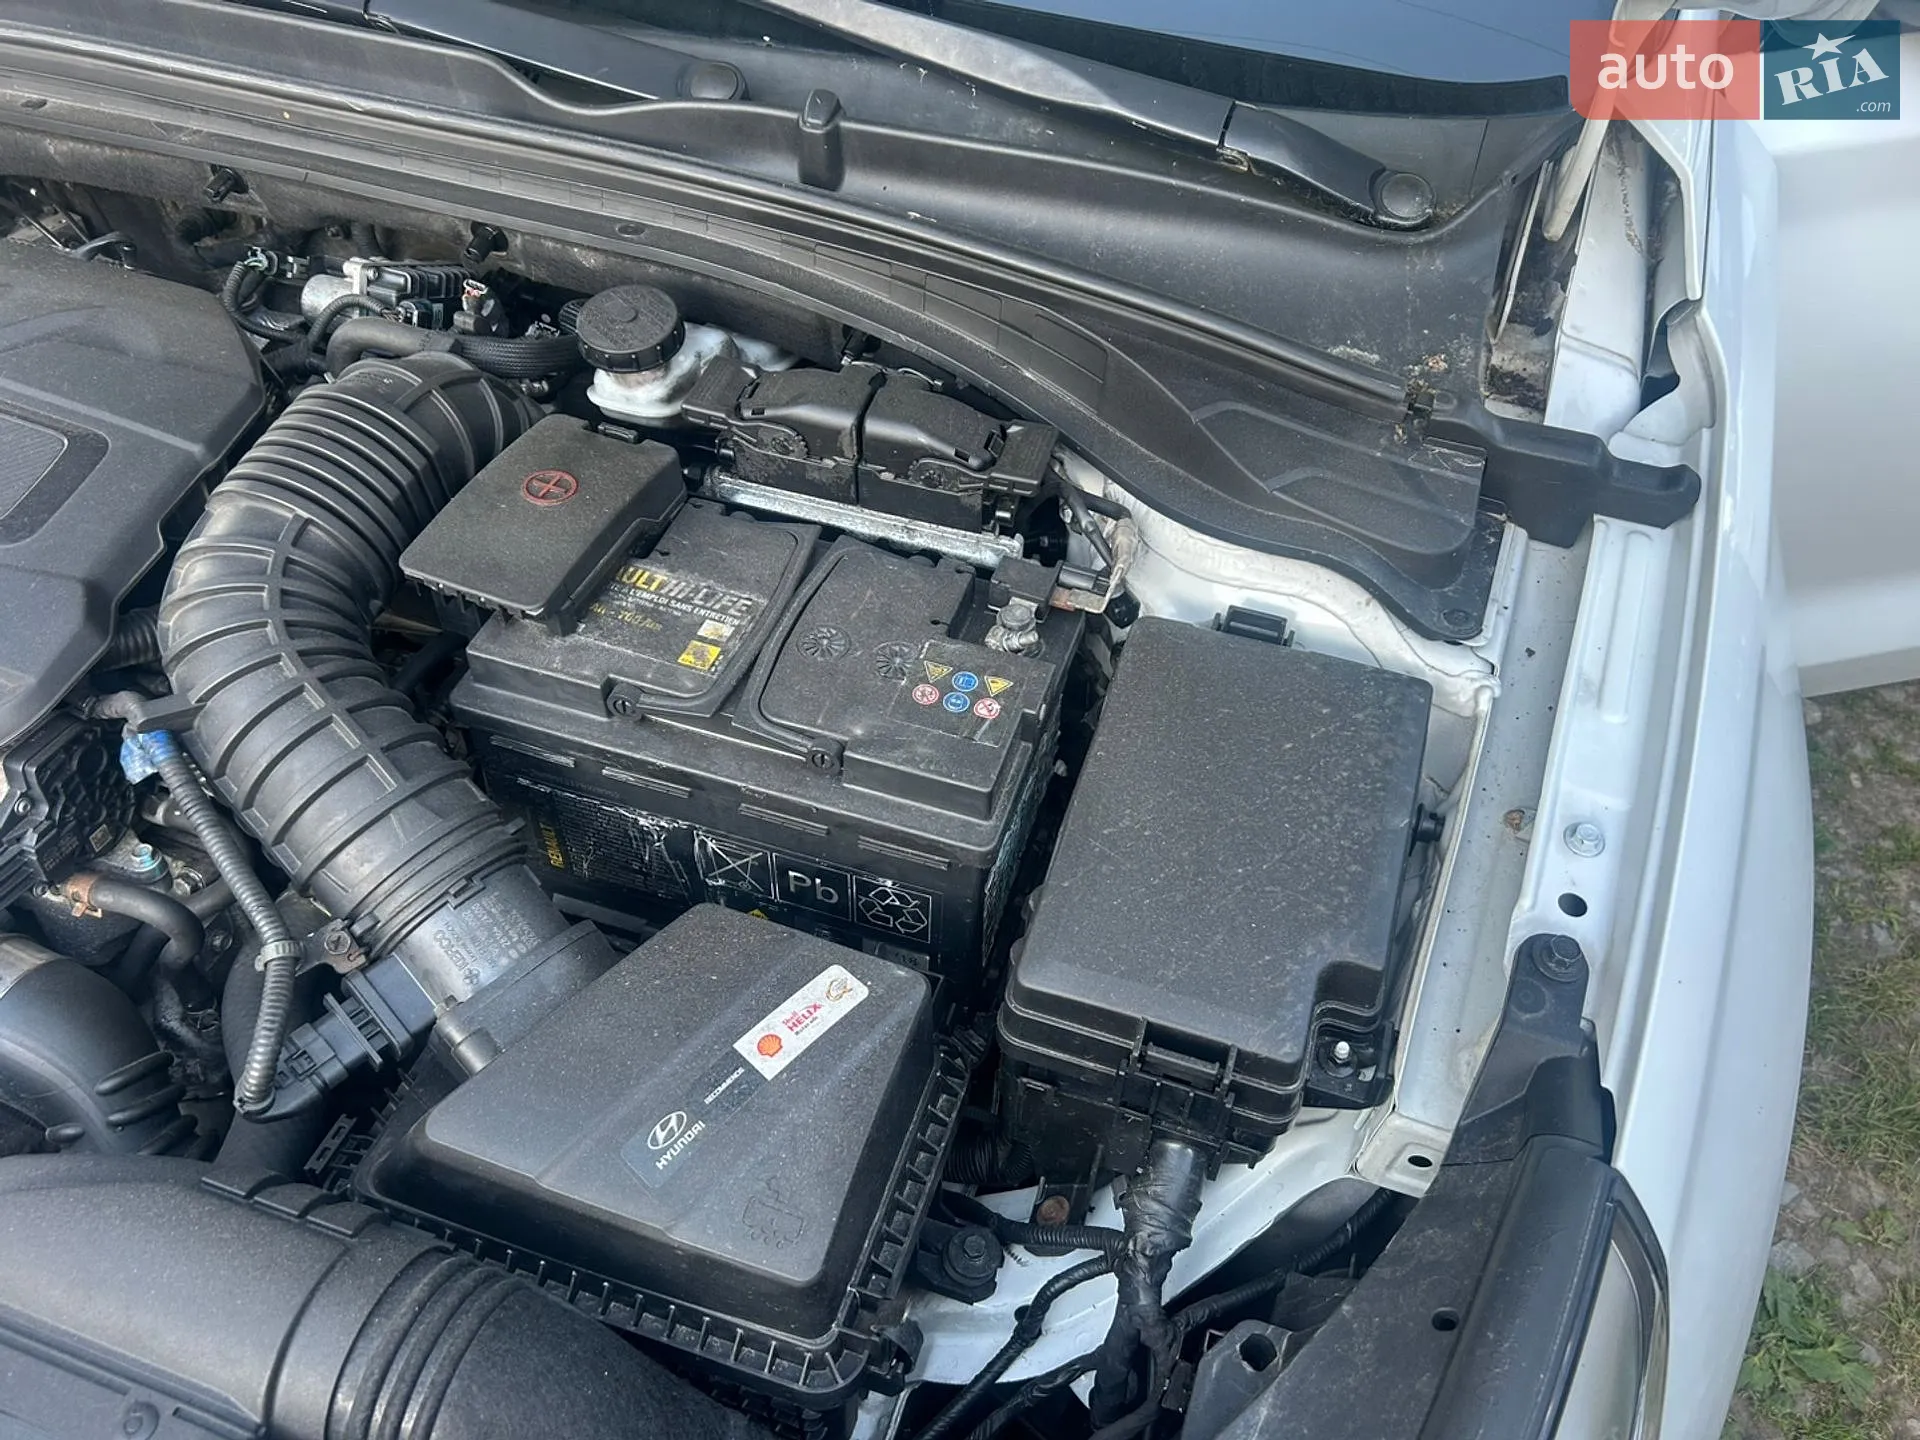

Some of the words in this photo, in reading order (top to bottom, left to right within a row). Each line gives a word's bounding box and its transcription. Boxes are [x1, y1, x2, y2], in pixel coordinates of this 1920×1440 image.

[788, 870, 839, 904] Pb
[787, 1002, 822, 1033] HELIX
[655, 1120, 706, 1170] HYUNDAI
